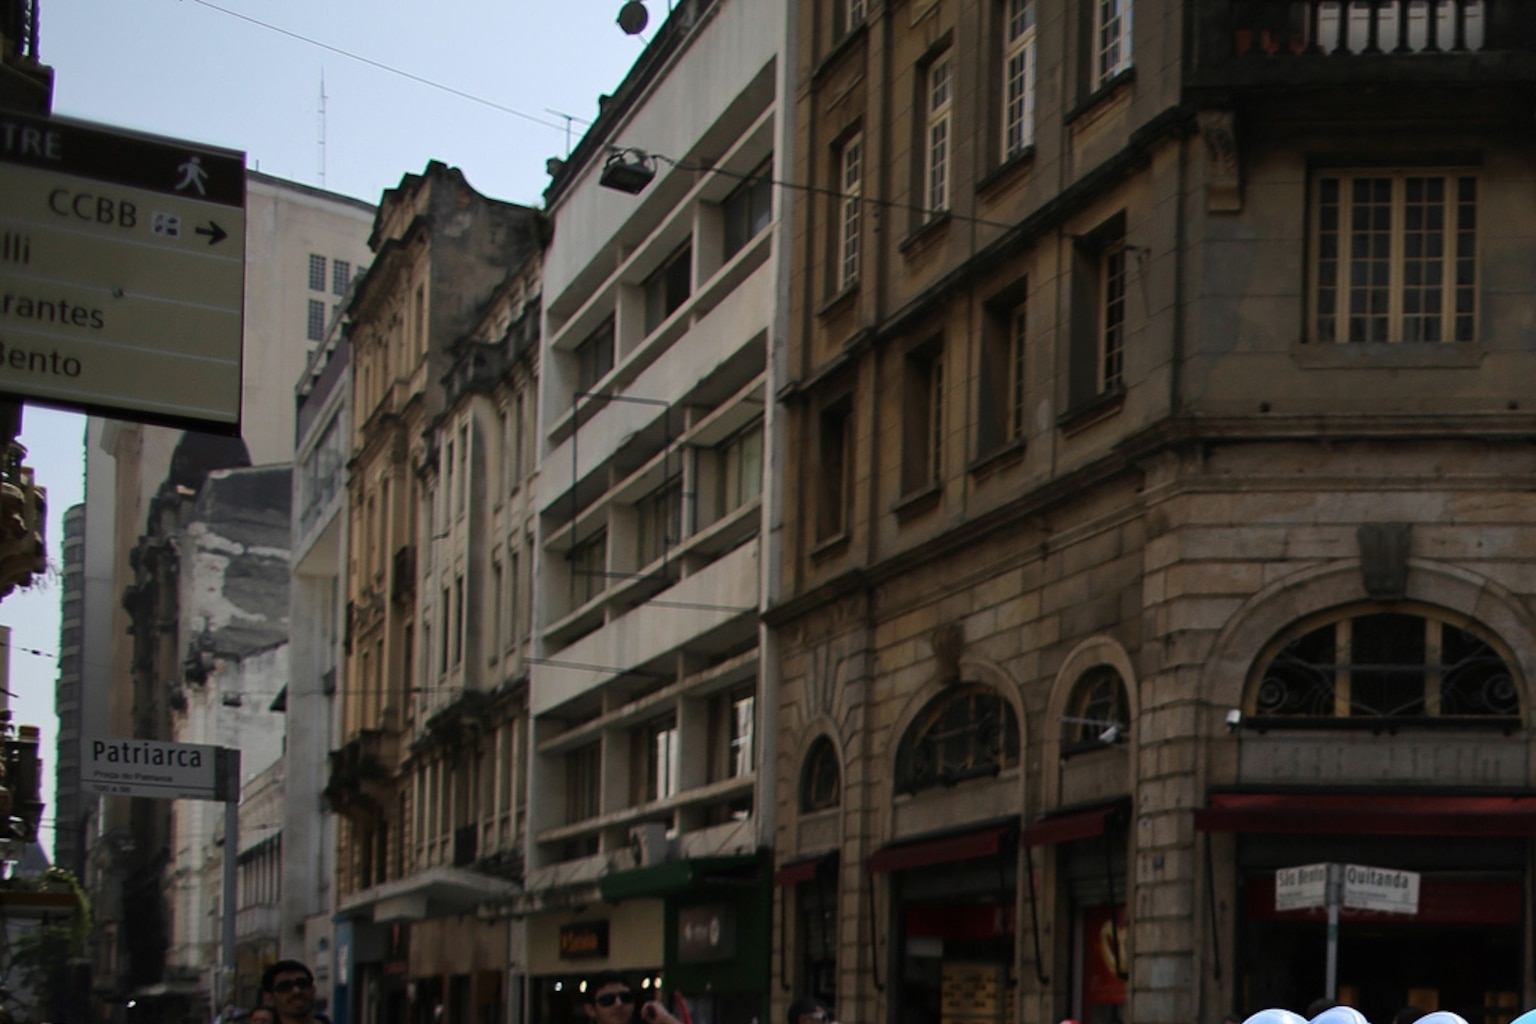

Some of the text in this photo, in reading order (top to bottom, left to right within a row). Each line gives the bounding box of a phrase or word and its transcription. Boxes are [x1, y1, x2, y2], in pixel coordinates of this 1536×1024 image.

[2, 123, 63, 160] TRE
[48, 188, 137, 229] CCBB
[3, 294, 104, 329] rantes
[0, 341, 82, 378] ento
[93, 741, 202, 768] Patriarca
[1347, 867, 1409, 889] Quitanda
